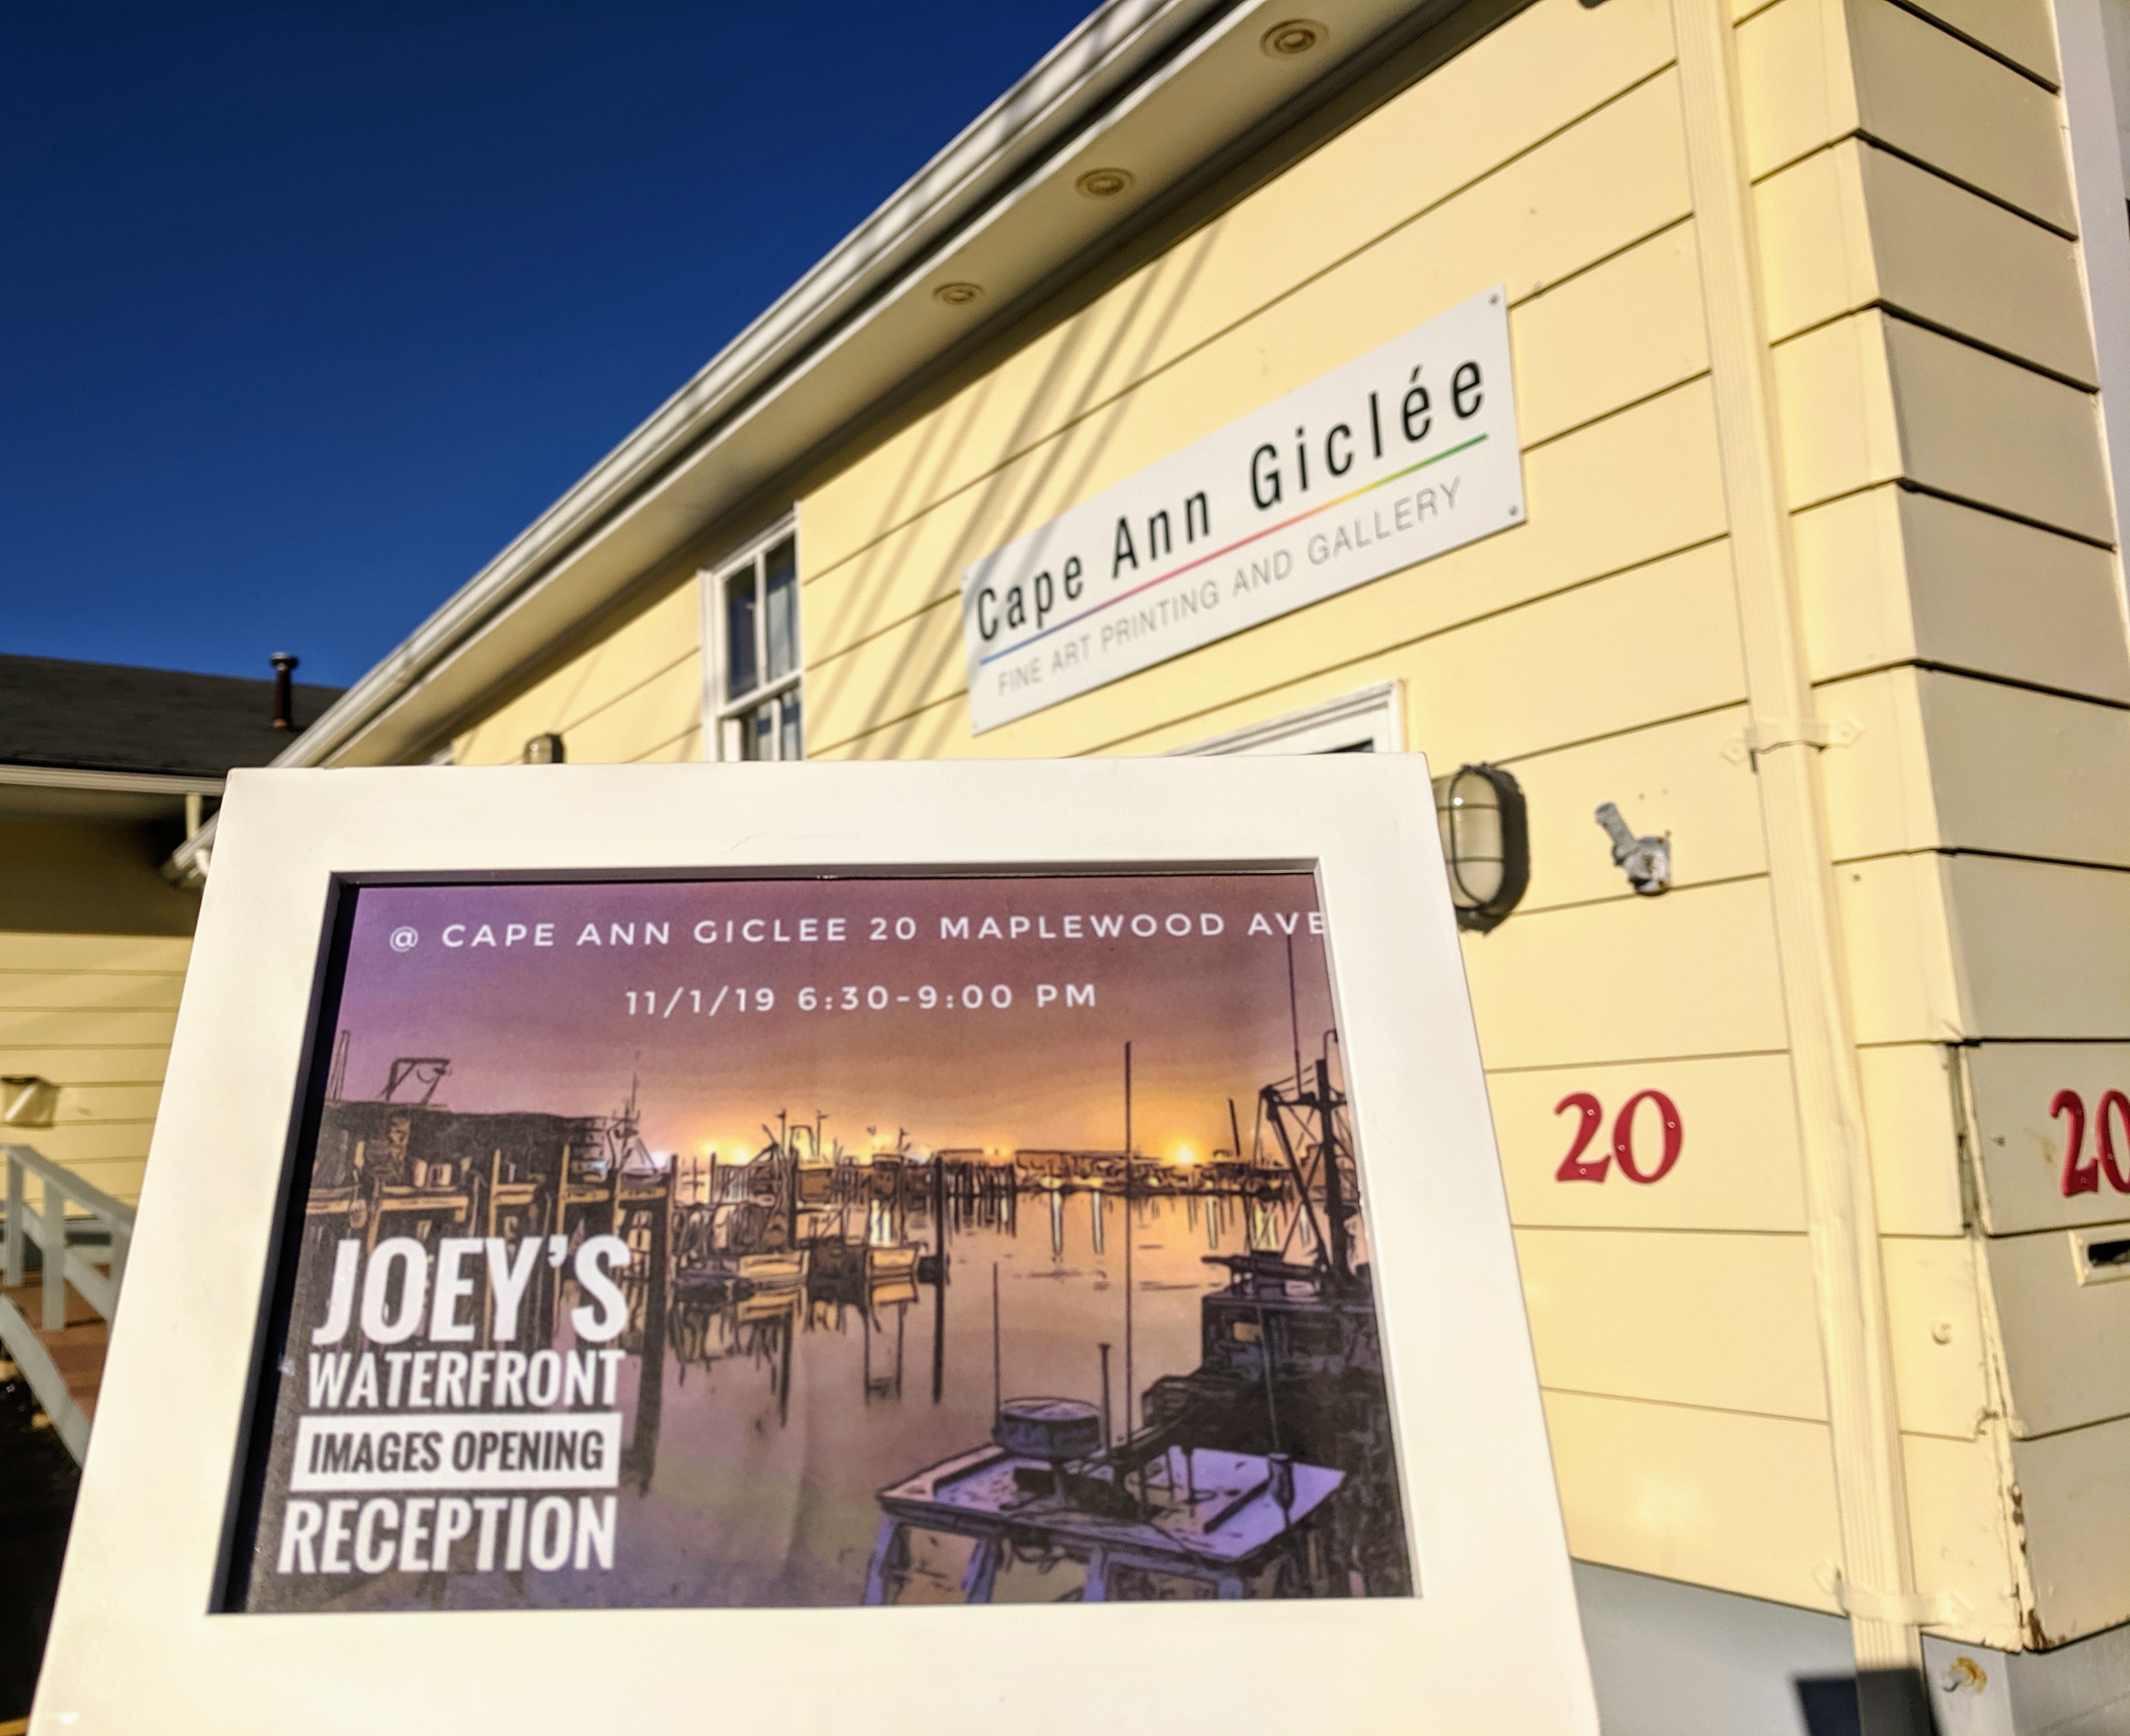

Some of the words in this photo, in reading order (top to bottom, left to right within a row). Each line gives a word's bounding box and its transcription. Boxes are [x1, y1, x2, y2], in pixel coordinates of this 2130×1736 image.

[977, 554, 1084, 642] Cape
[1111, 490, 1211, 579] Ann
[1248, 359, 1485, 512] Giclée
[998, 659, 1042, 696] FINE
[1051, 634, 1092, 675] ART
[1100, 579, 1220, 652] PRINTING
[1232, 549, 1294, 598] AND
[1307, 476, 1461, 566] GALLERY
[389, 925, 419, 953] @
[442, 923, 556, 947] CAPE
[576, 922, 670, 946] ANN
[694, 918, 847, 944] GICLEE
[869, 916, 917, 941] 20
[939, 913, 1225, 940] MAPLEWOOD
[1247, 911, 1324, 936] AVE
[626, 985, 776, 1018] 11/1/19
[798, 984, 1013, 1012] 6:30-9:00
[1035, 984, 1097, 1008] PM
[1554, 1088, 1684, 1185] 20
[2049, 1088, 2130, 1198] 20
[313, 1234, 632, 1345] JOEY'S
[307, 1349, 627, 1408] WATERFRONT
[309, 1430, 443, 1474] IMAGES
[451, 1429, 604, 1472] OPENING
[277, 1495, 618, 1575] RECEPTION
